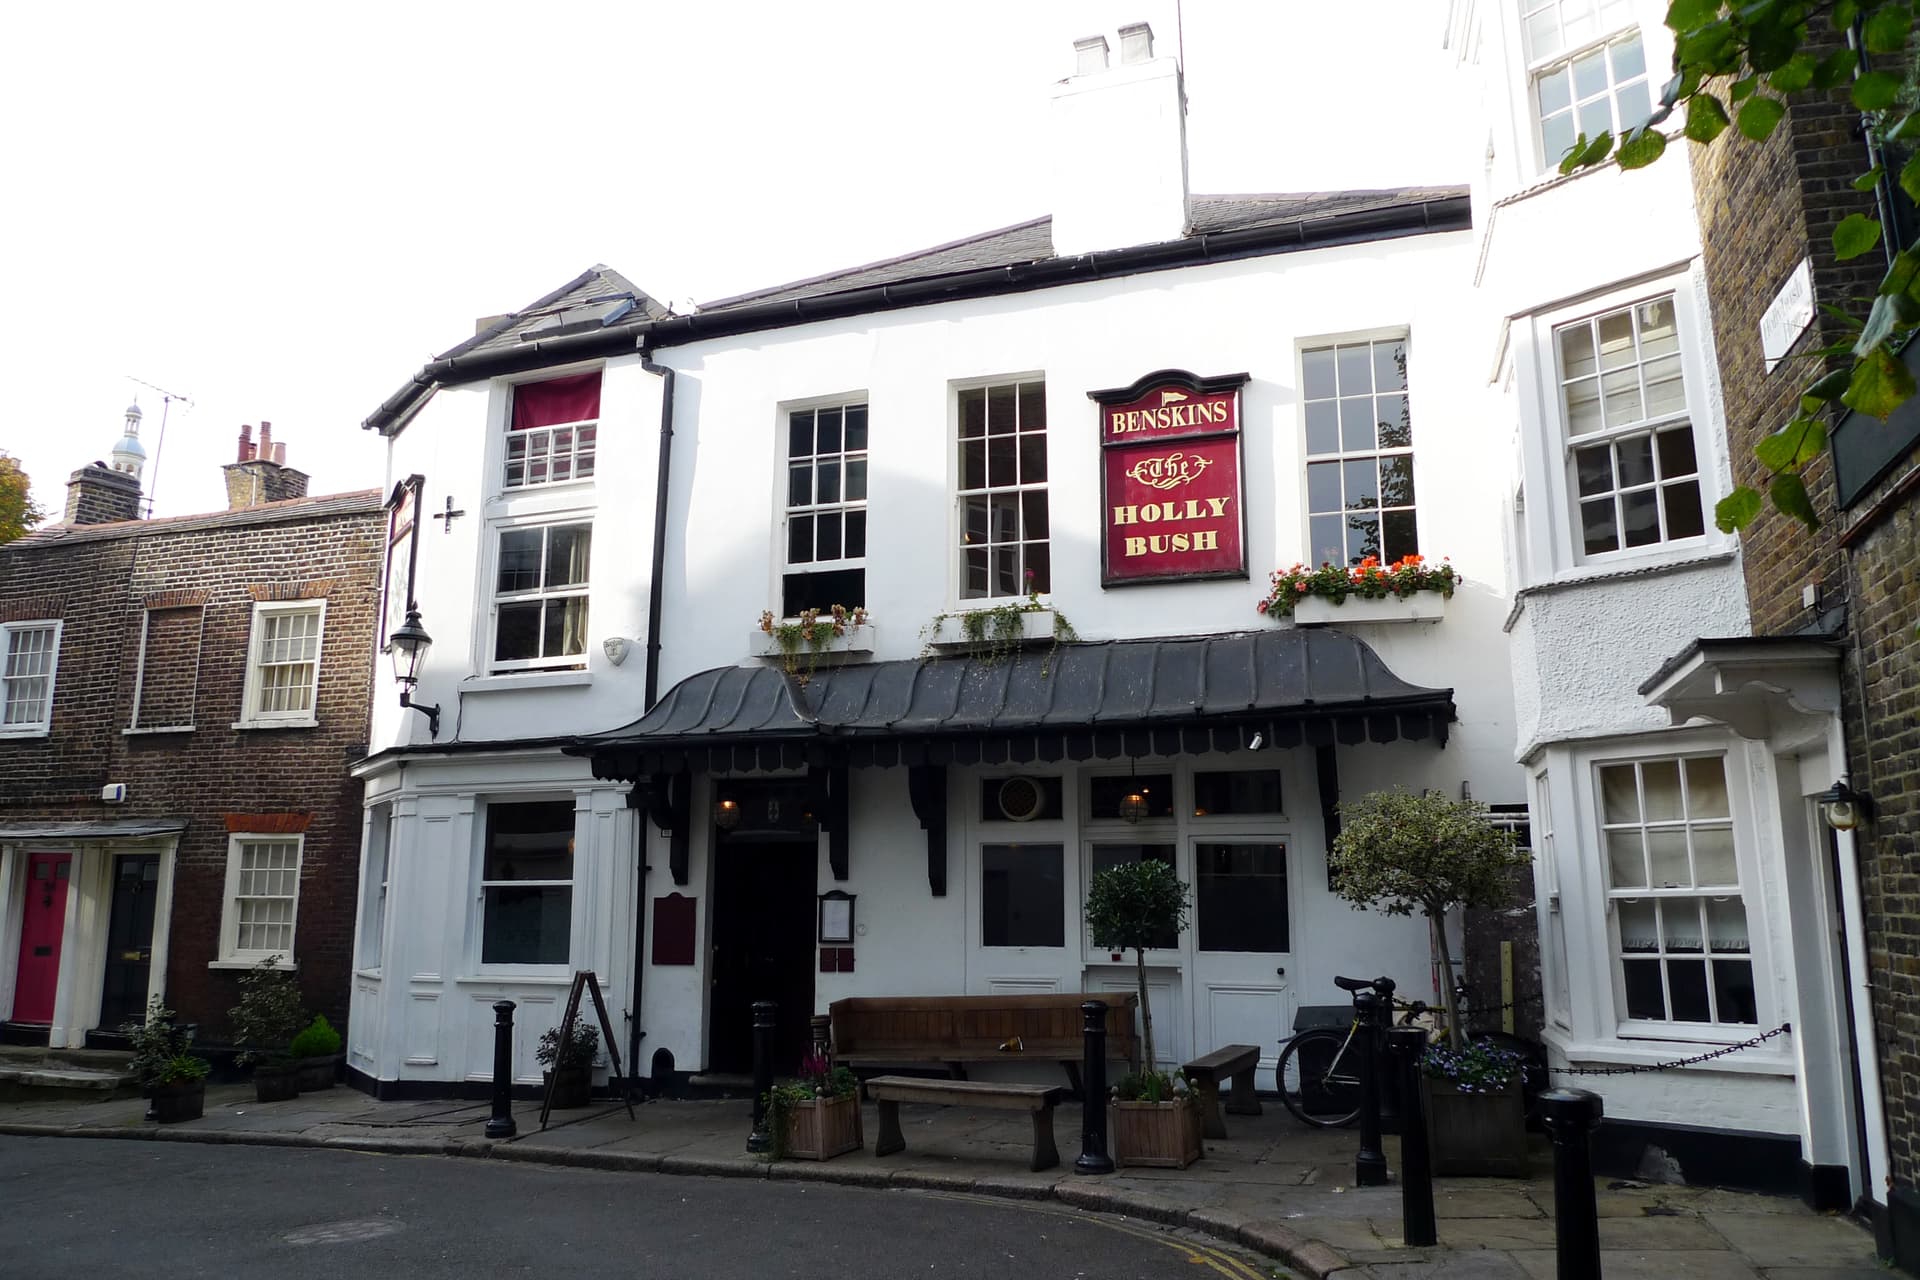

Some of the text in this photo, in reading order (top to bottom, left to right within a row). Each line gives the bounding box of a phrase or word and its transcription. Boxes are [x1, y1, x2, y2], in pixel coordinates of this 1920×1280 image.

[1111, 400, 1228, 434] BENSKINS
[1148, 452, 1191, 478] The
[1113, 496, 1231, 526] HOLLY
[1124, 530, 1219, 557] BUSH
